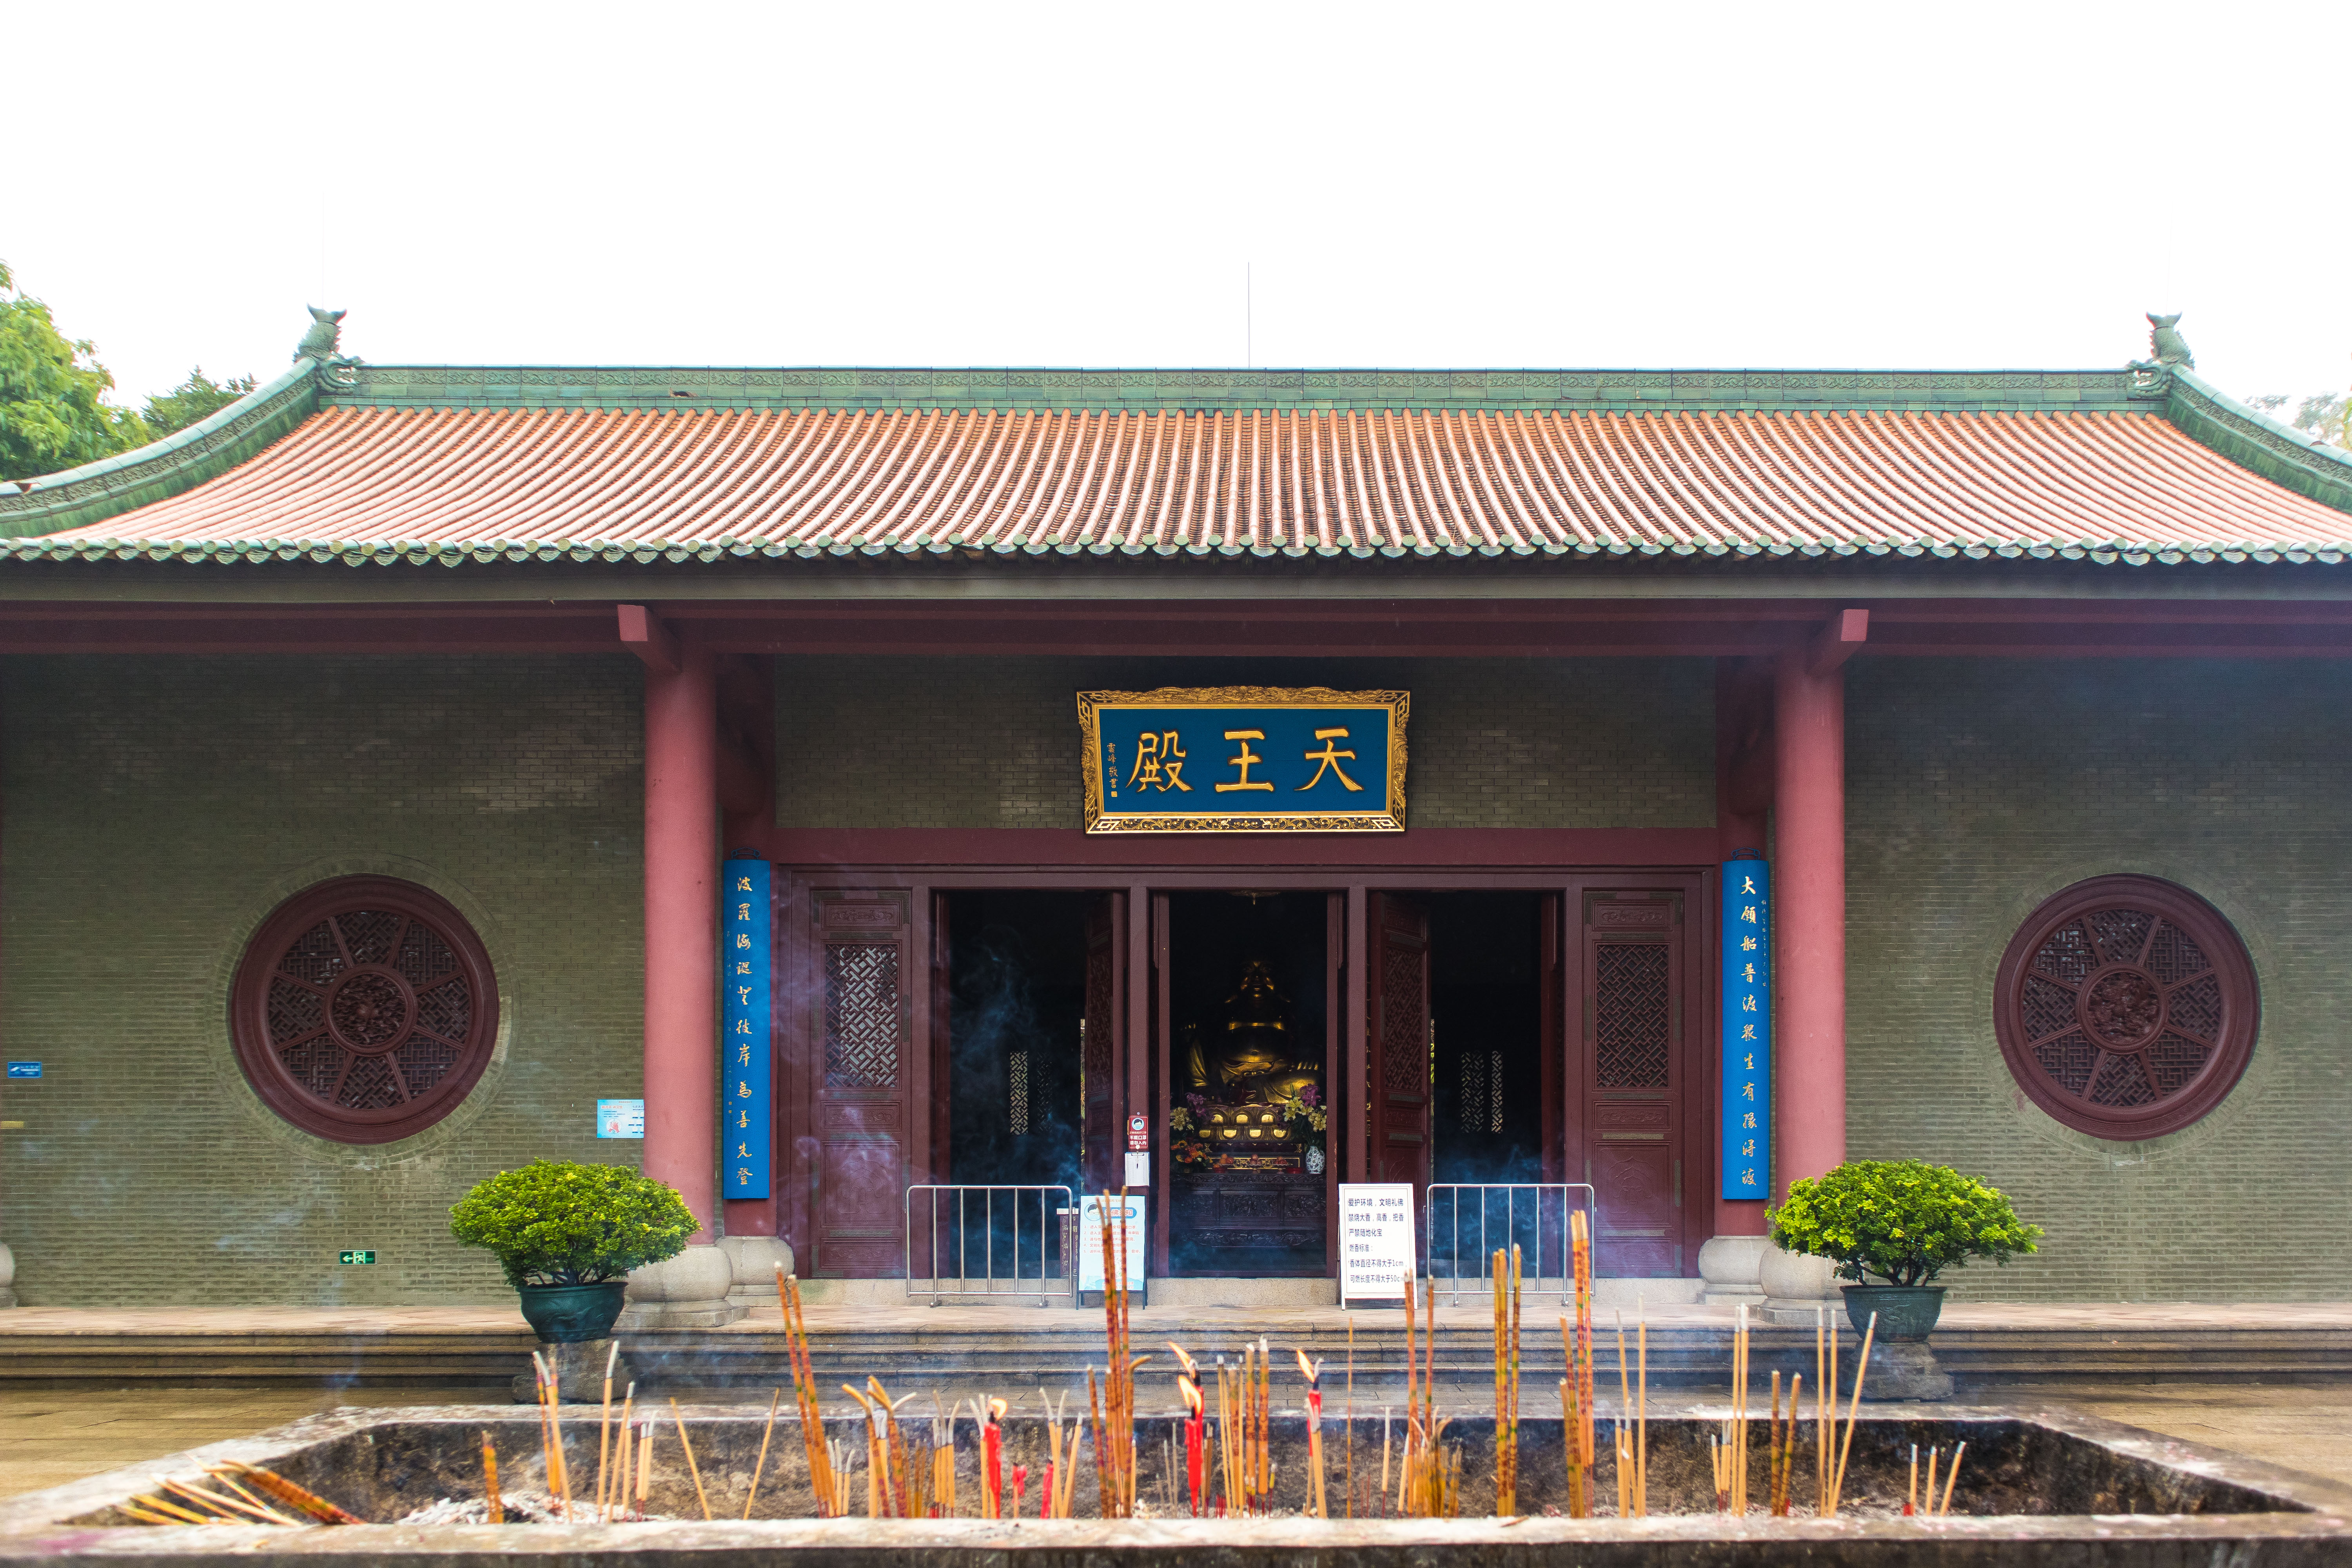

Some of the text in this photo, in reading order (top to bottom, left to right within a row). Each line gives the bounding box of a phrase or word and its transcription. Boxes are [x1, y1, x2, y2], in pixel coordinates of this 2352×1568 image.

[1125, 727, 1364, 793] 天王殿
[1348, 1228, 1383, 1237] 严禁随地化宝
